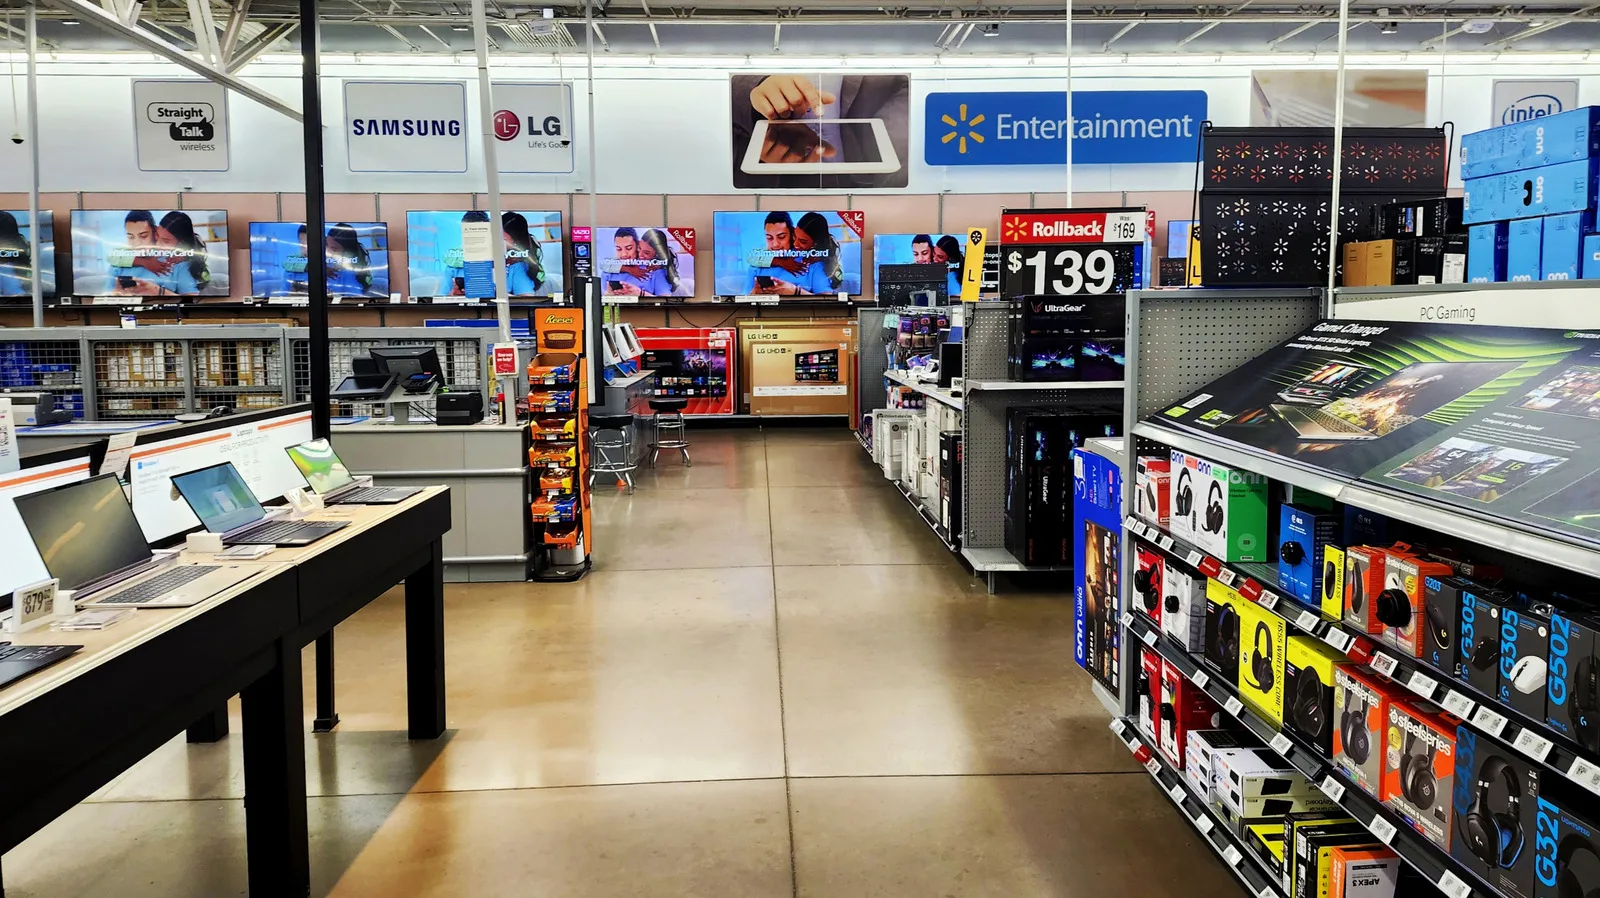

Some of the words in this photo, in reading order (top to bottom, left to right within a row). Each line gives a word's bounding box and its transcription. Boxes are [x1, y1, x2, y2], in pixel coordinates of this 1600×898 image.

[158, 108, 204, 120] Straight
[180, 126, 204, 137] Talk
[352, 118, 460, 136] SAMSUNG
[528, 116, 561, 136] LG
[997, 113, 1192, 140] Entertainment
[180, 142, 215, 152] wireless
[528, 141, 547, 149] Life's
[1536, 127, 1544, 155] onn
[1536, 176, 1544, 204] onn
[842, 212, 862, 234] Rollback
[1032, 220, 1102, 238] Rollback
[1114, 222, 1136, 239] $169
[672, 230, 692, 252] Rollback
[631, 258, 668, 267] MoneyCard
[784, 249, 830, 259] MoneyCard
[968, 270, 975, 282] L
[1007, 249, 1115, 296] $139
[1044, 304, 1082, 312] UltraGear
[1420, 306, 1434, 320] PC
[1436, 305, 1476, 322] Gaming
[1312, 322, 1344, 332] Game
[1340, 324, 1390, 336] Changer
[1172, 451, 1184, 465] onn
[1198, 461, 1212, 476] onn
[1230, 471, 1268, 484] onn
[1387, 557, 1418, 576] steelseries
[1242, 584, 1258, 596] Rollback
[1424, 576, 1440, 592] G203
[1461, 591, 1476, 658] G305
[1500, 608, 1520, 680] G305
[1548, 613, 1570, 706] G502
[1340, 673, 1379, 708] steelseries
[1398, 714, 1451, 756] steelseries
[1454, 725, 1476, 816] G432
[1536, 796, 1560, 888] G321
[1358, 878, 1380, 886] APEX
